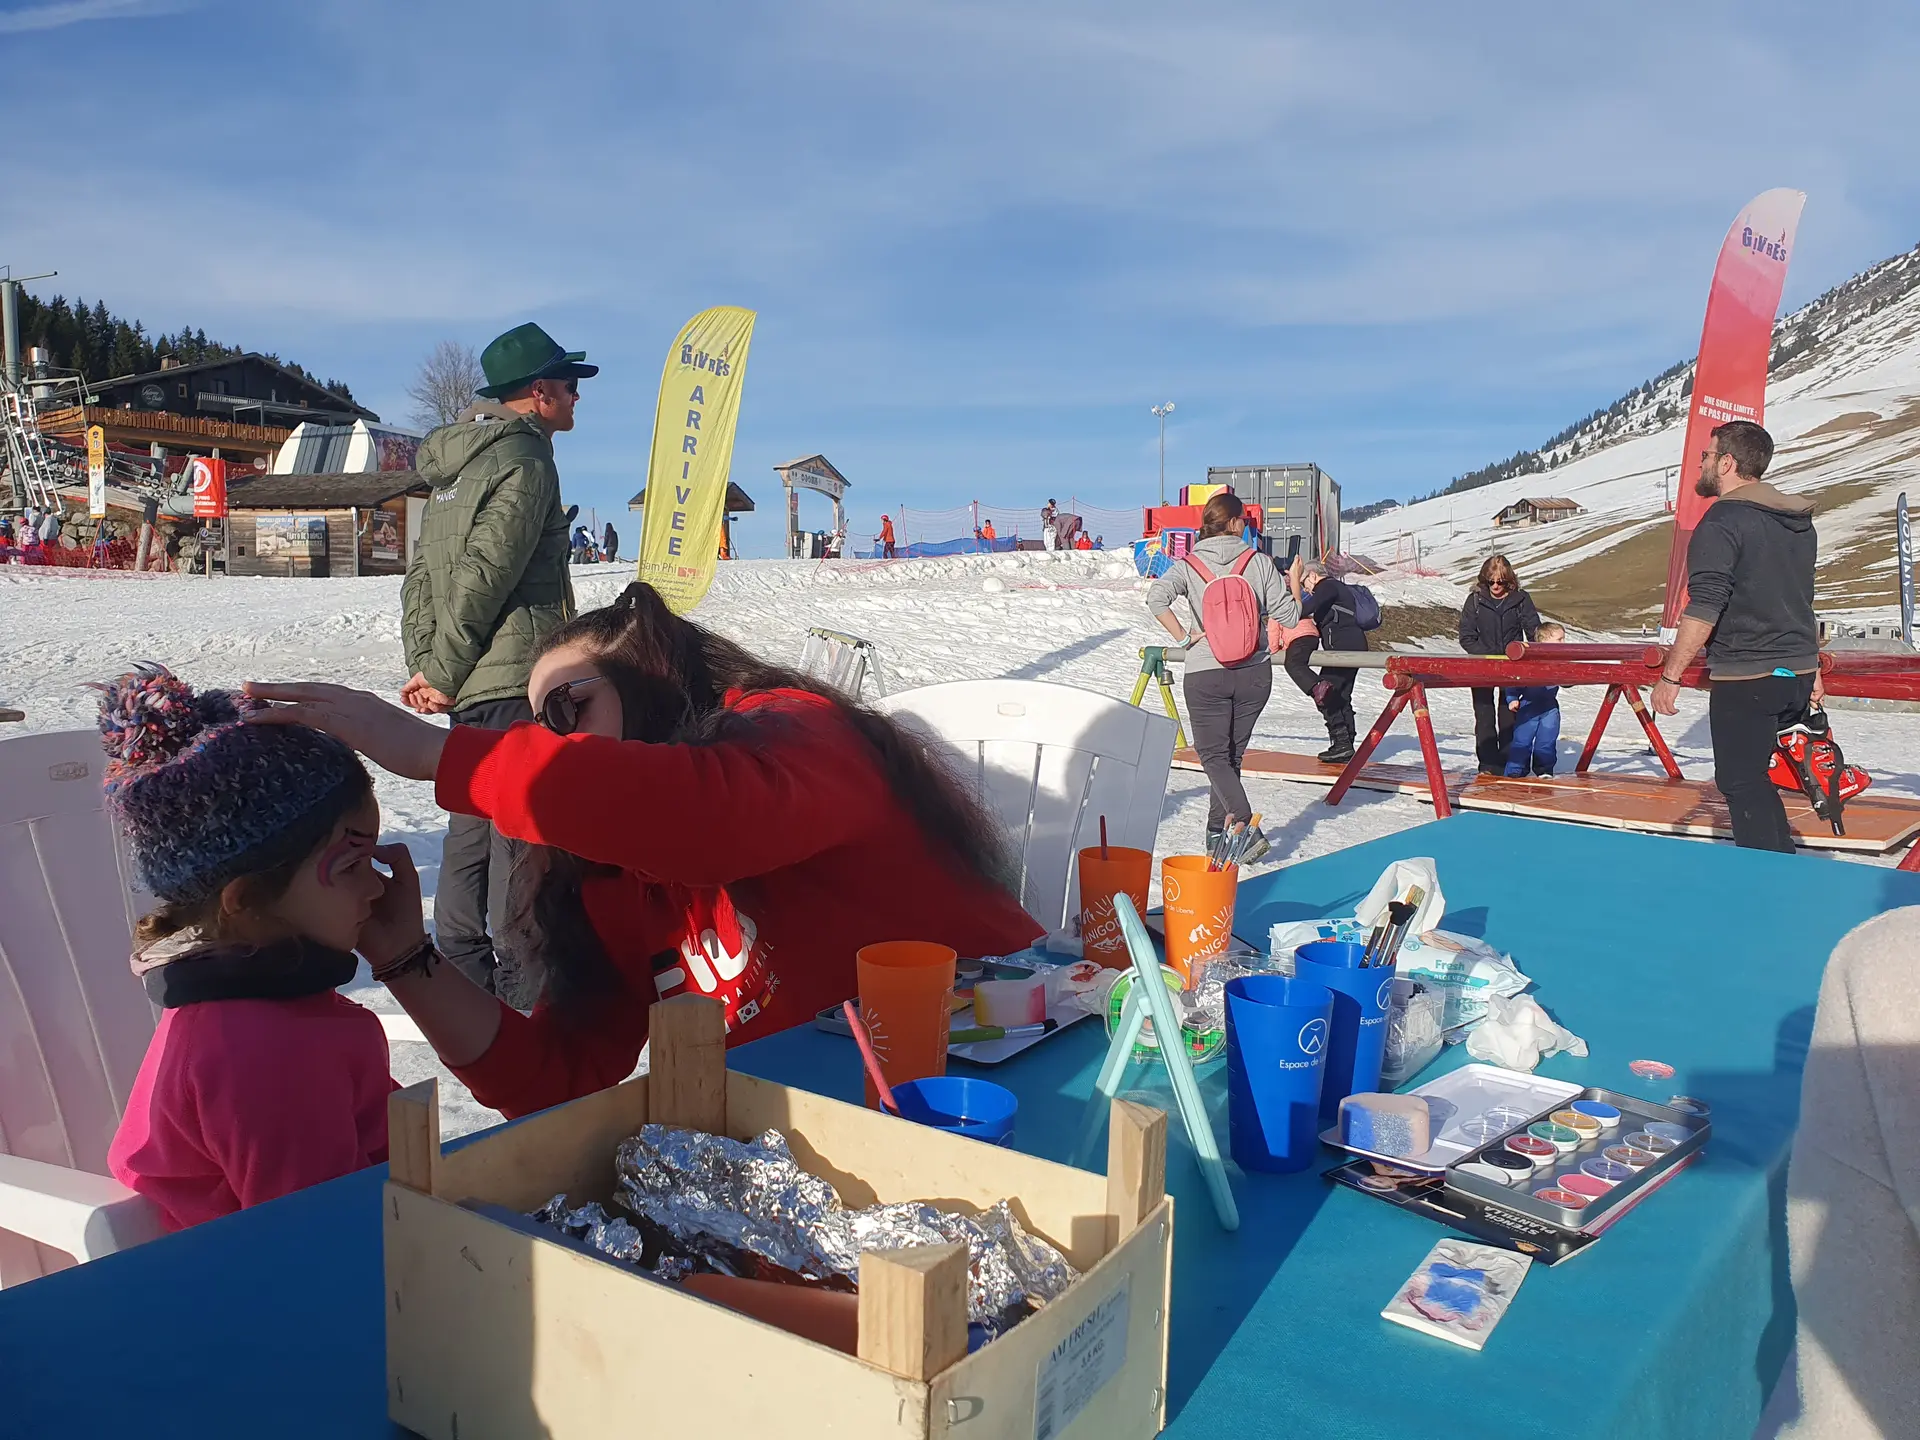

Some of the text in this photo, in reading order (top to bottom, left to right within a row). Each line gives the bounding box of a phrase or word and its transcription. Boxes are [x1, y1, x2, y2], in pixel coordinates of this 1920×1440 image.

[1698, 405, 1709, 417] NE
[1708, 408, 1722, 420] PAS
[1721, 412, 1732, 422] EN
[1703, 394, 1716, 406] UNE
[1715, 398, 1733, 411] SEULE
[1733, 403, 1755, 416] LIMITE
[667, 384, 705, 557] ARRIVEE
[1435, 960, 1465, 972] Fresh
[1451, 974, 1471, 985] VERA
[1280, 1058, 1310, 1071] Espace
[1483, 1205, 1558, 1235] PLANTILLA
[1484, 1211, 1540, 1236] STENCIL
